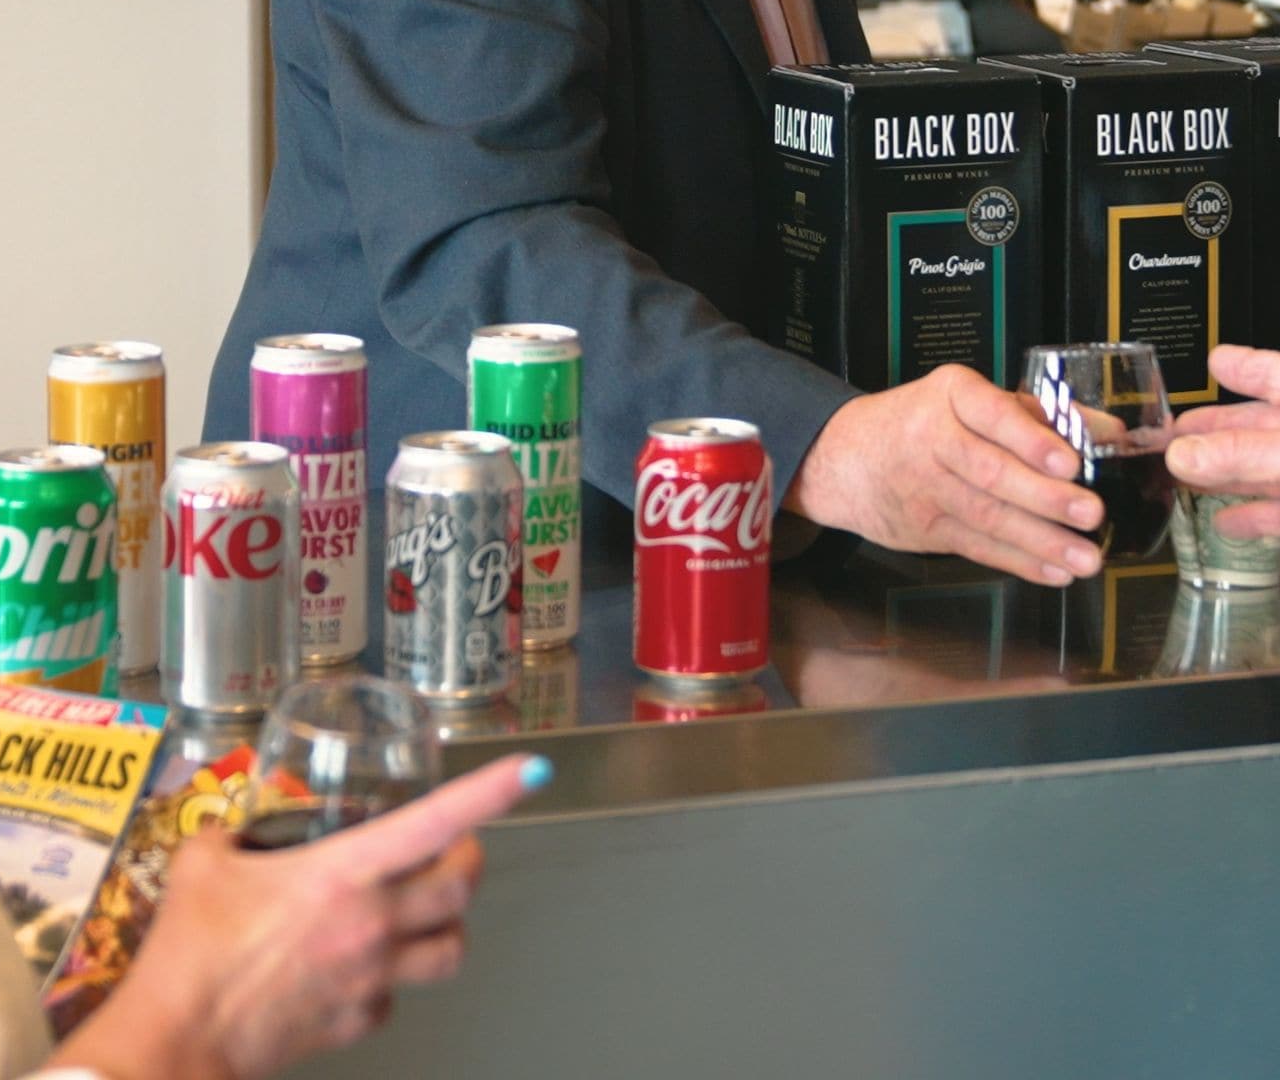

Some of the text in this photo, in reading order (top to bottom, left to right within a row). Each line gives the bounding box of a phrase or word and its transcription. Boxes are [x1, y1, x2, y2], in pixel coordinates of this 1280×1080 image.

[775, 103, 835, 158] BLACK BOX
[874, 111, 1015, 160] BLACK BOX
[1096, 107, 1231, 156] BLACK BOX
[903, 169, 990, 182] PREMIUM WINES
[979, 204, 1007, 221] 100
[1196, 198, 1221, 215] 100
[908, 255, 986, 278] Pinot Grigio
[1128, 253, 1202, 271] Chardonnay
[921, 284, 972, 295] CALIFORNIA
[42, 738, 138, 792] HILLS
